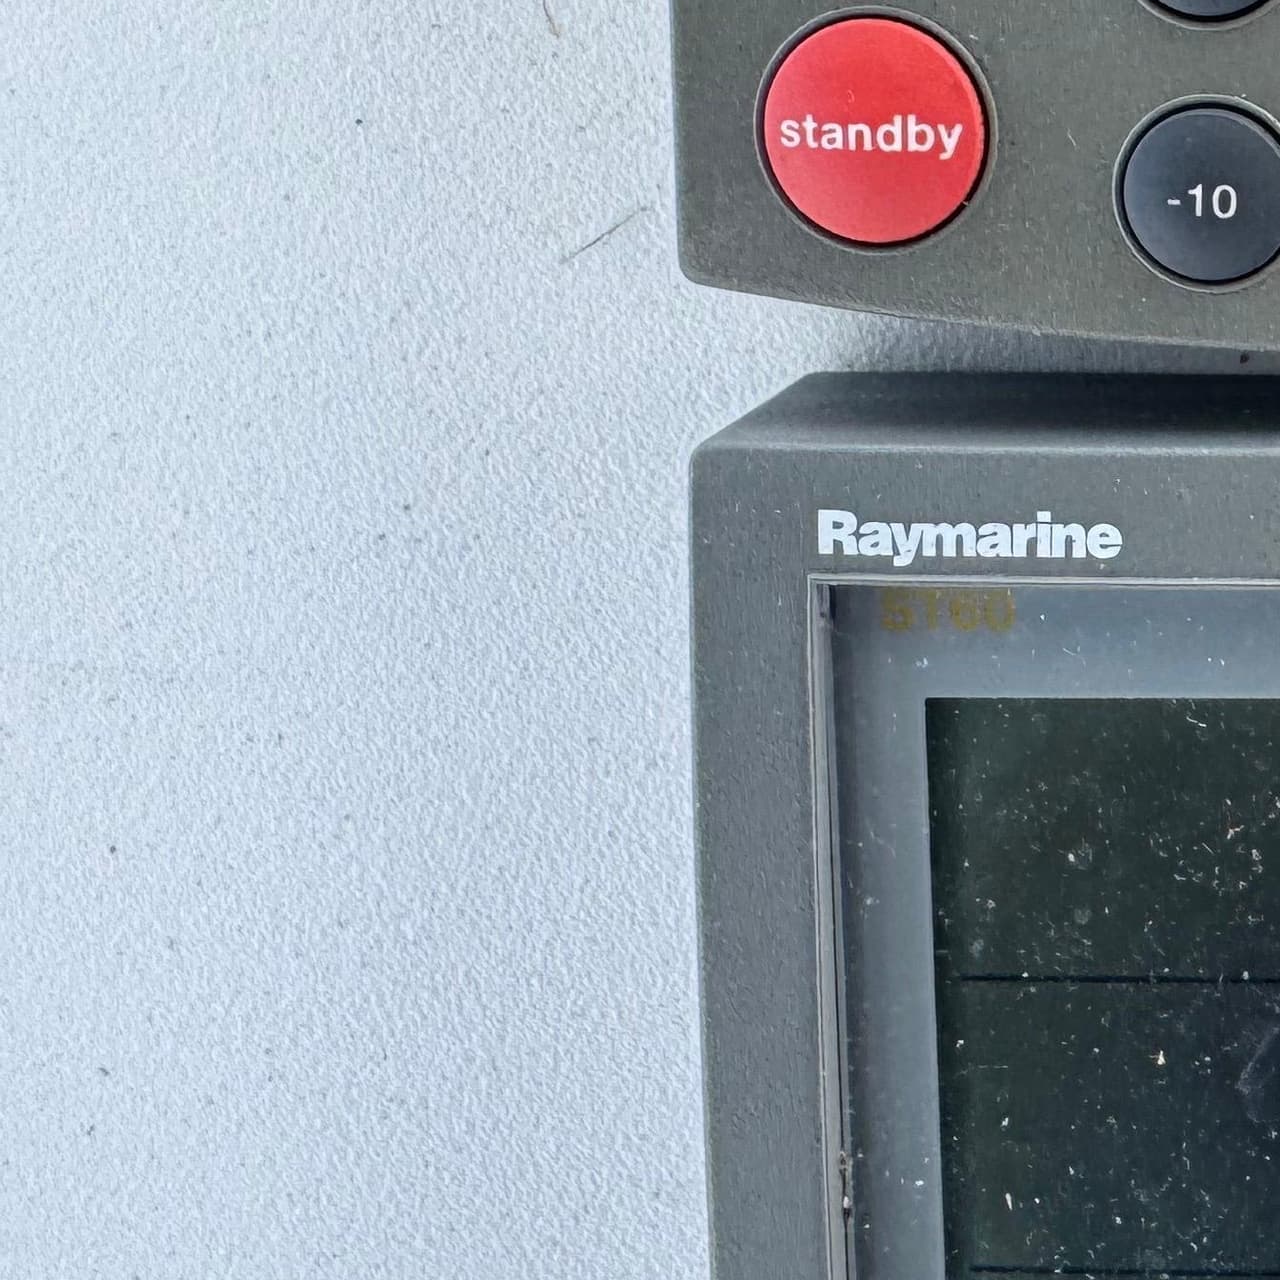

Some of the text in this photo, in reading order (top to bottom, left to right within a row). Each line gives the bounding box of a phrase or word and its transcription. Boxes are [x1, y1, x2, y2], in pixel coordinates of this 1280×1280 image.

[780, 114, 963, 160] standby
[1167, 184, 1237, 219] -10
[817, 510, 1122, 566] Raymarine
